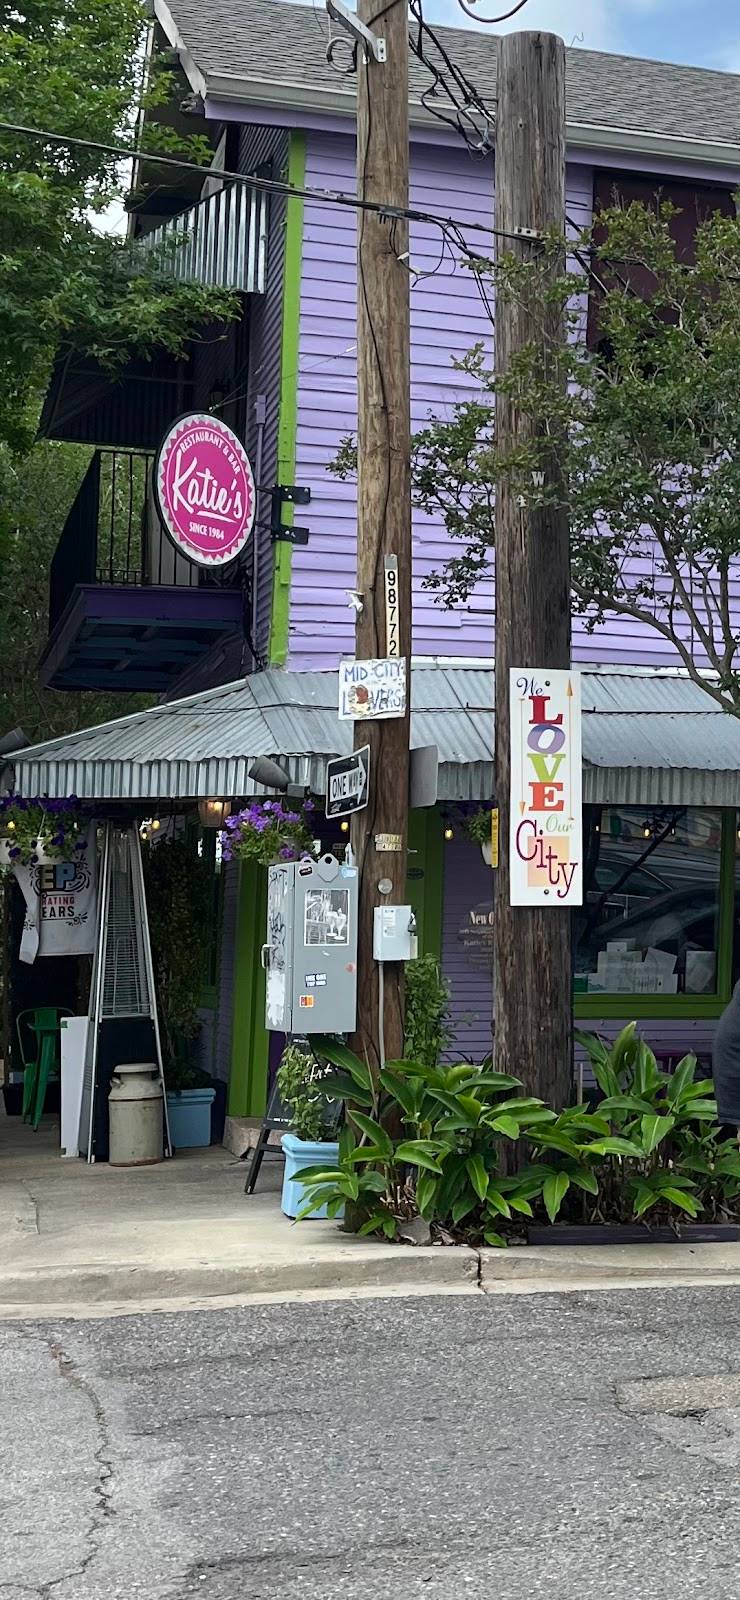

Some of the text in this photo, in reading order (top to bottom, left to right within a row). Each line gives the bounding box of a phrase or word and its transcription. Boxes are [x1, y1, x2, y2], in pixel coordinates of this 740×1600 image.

[180, 432, 241, 475] RESTAURANT & BAR
[172, 449, 243, 519] Katie's
[189, 522, 225, 541] SINCE 1984
[387, 571, 398, 656] 98772
[517, 676, 544, 697] We
[527, 695, 567, 812] LOVE
[332, 774, 347, 799] ONE
[545, 813, 575, 834] Our
[516, 819, 578, 898] City
